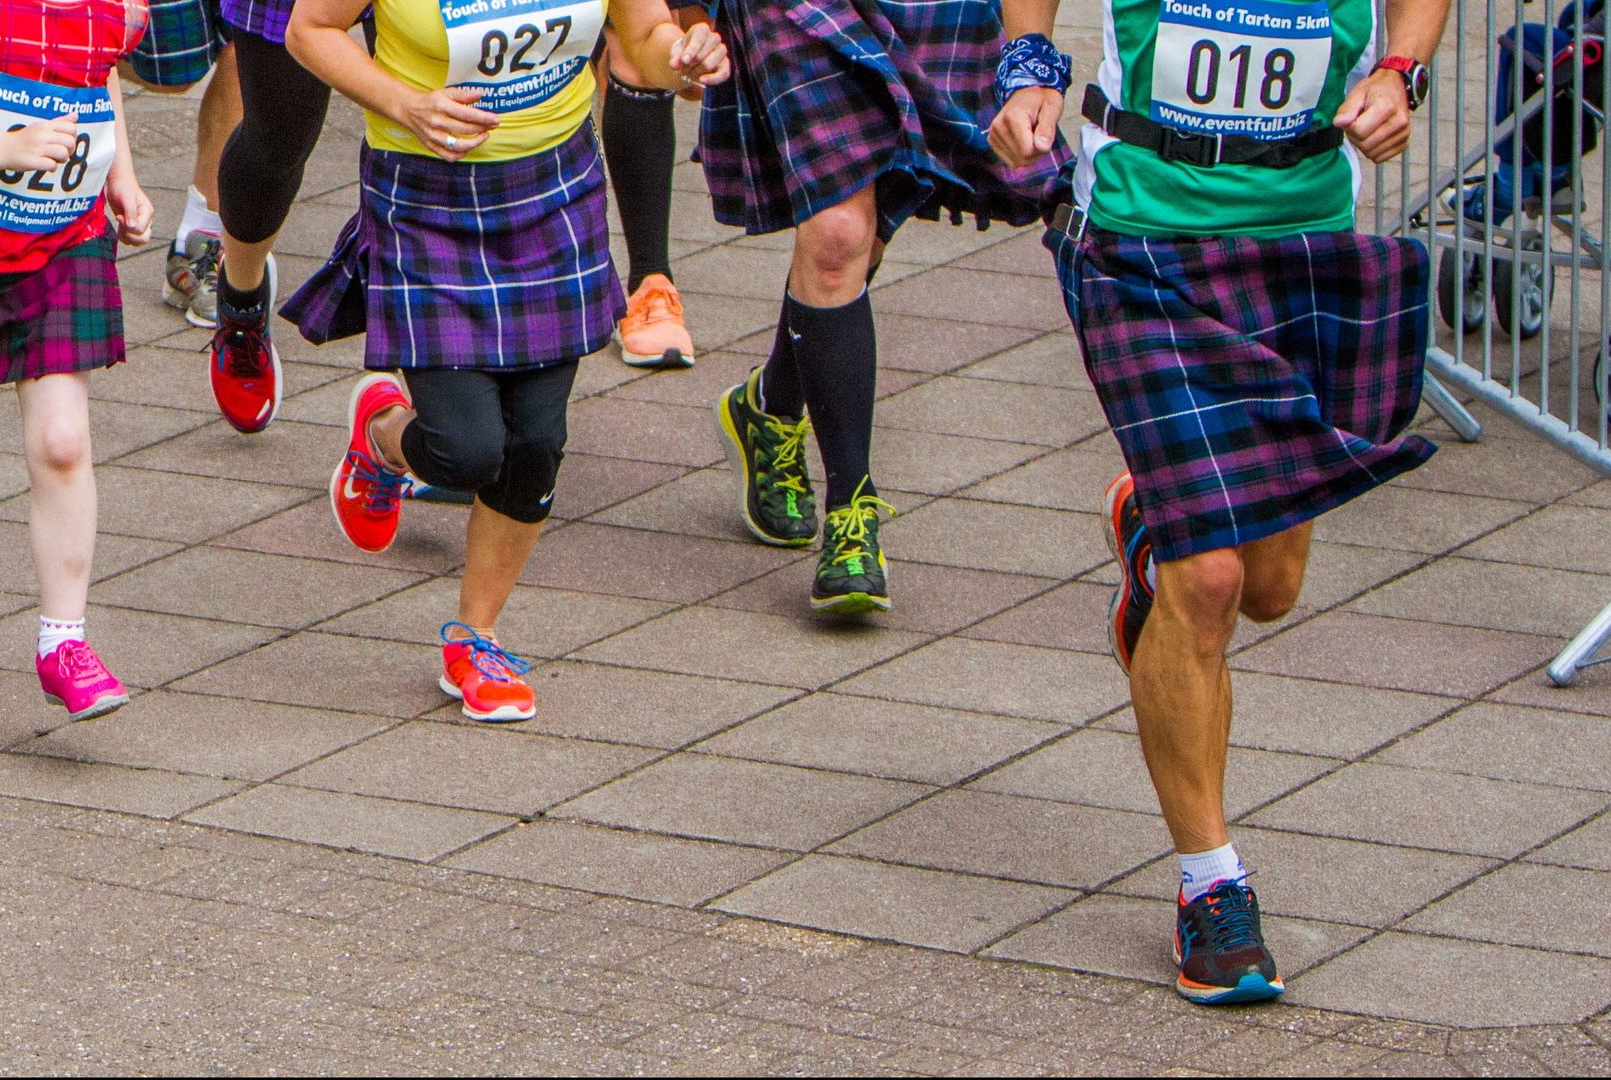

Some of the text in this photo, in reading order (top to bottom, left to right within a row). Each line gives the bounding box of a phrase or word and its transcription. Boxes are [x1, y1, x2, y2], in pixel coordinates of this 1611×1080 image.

[1215, 7, 1235, 22] of
[1237, 10, 1292, 29] Tartan
[1296, 16, 1330, 30] 5km
[478, 15, 572, 77] 027
[1186, 38, 1296, 110] 018
[32, 95, 51, 110] of
[52, 98, 93, 114] Tartan
[500, 90, 545, 108] Equipment
[1159, 106, 1307, 133] www.eventfull.biz
[7, 213, 52, 226] Equipment
